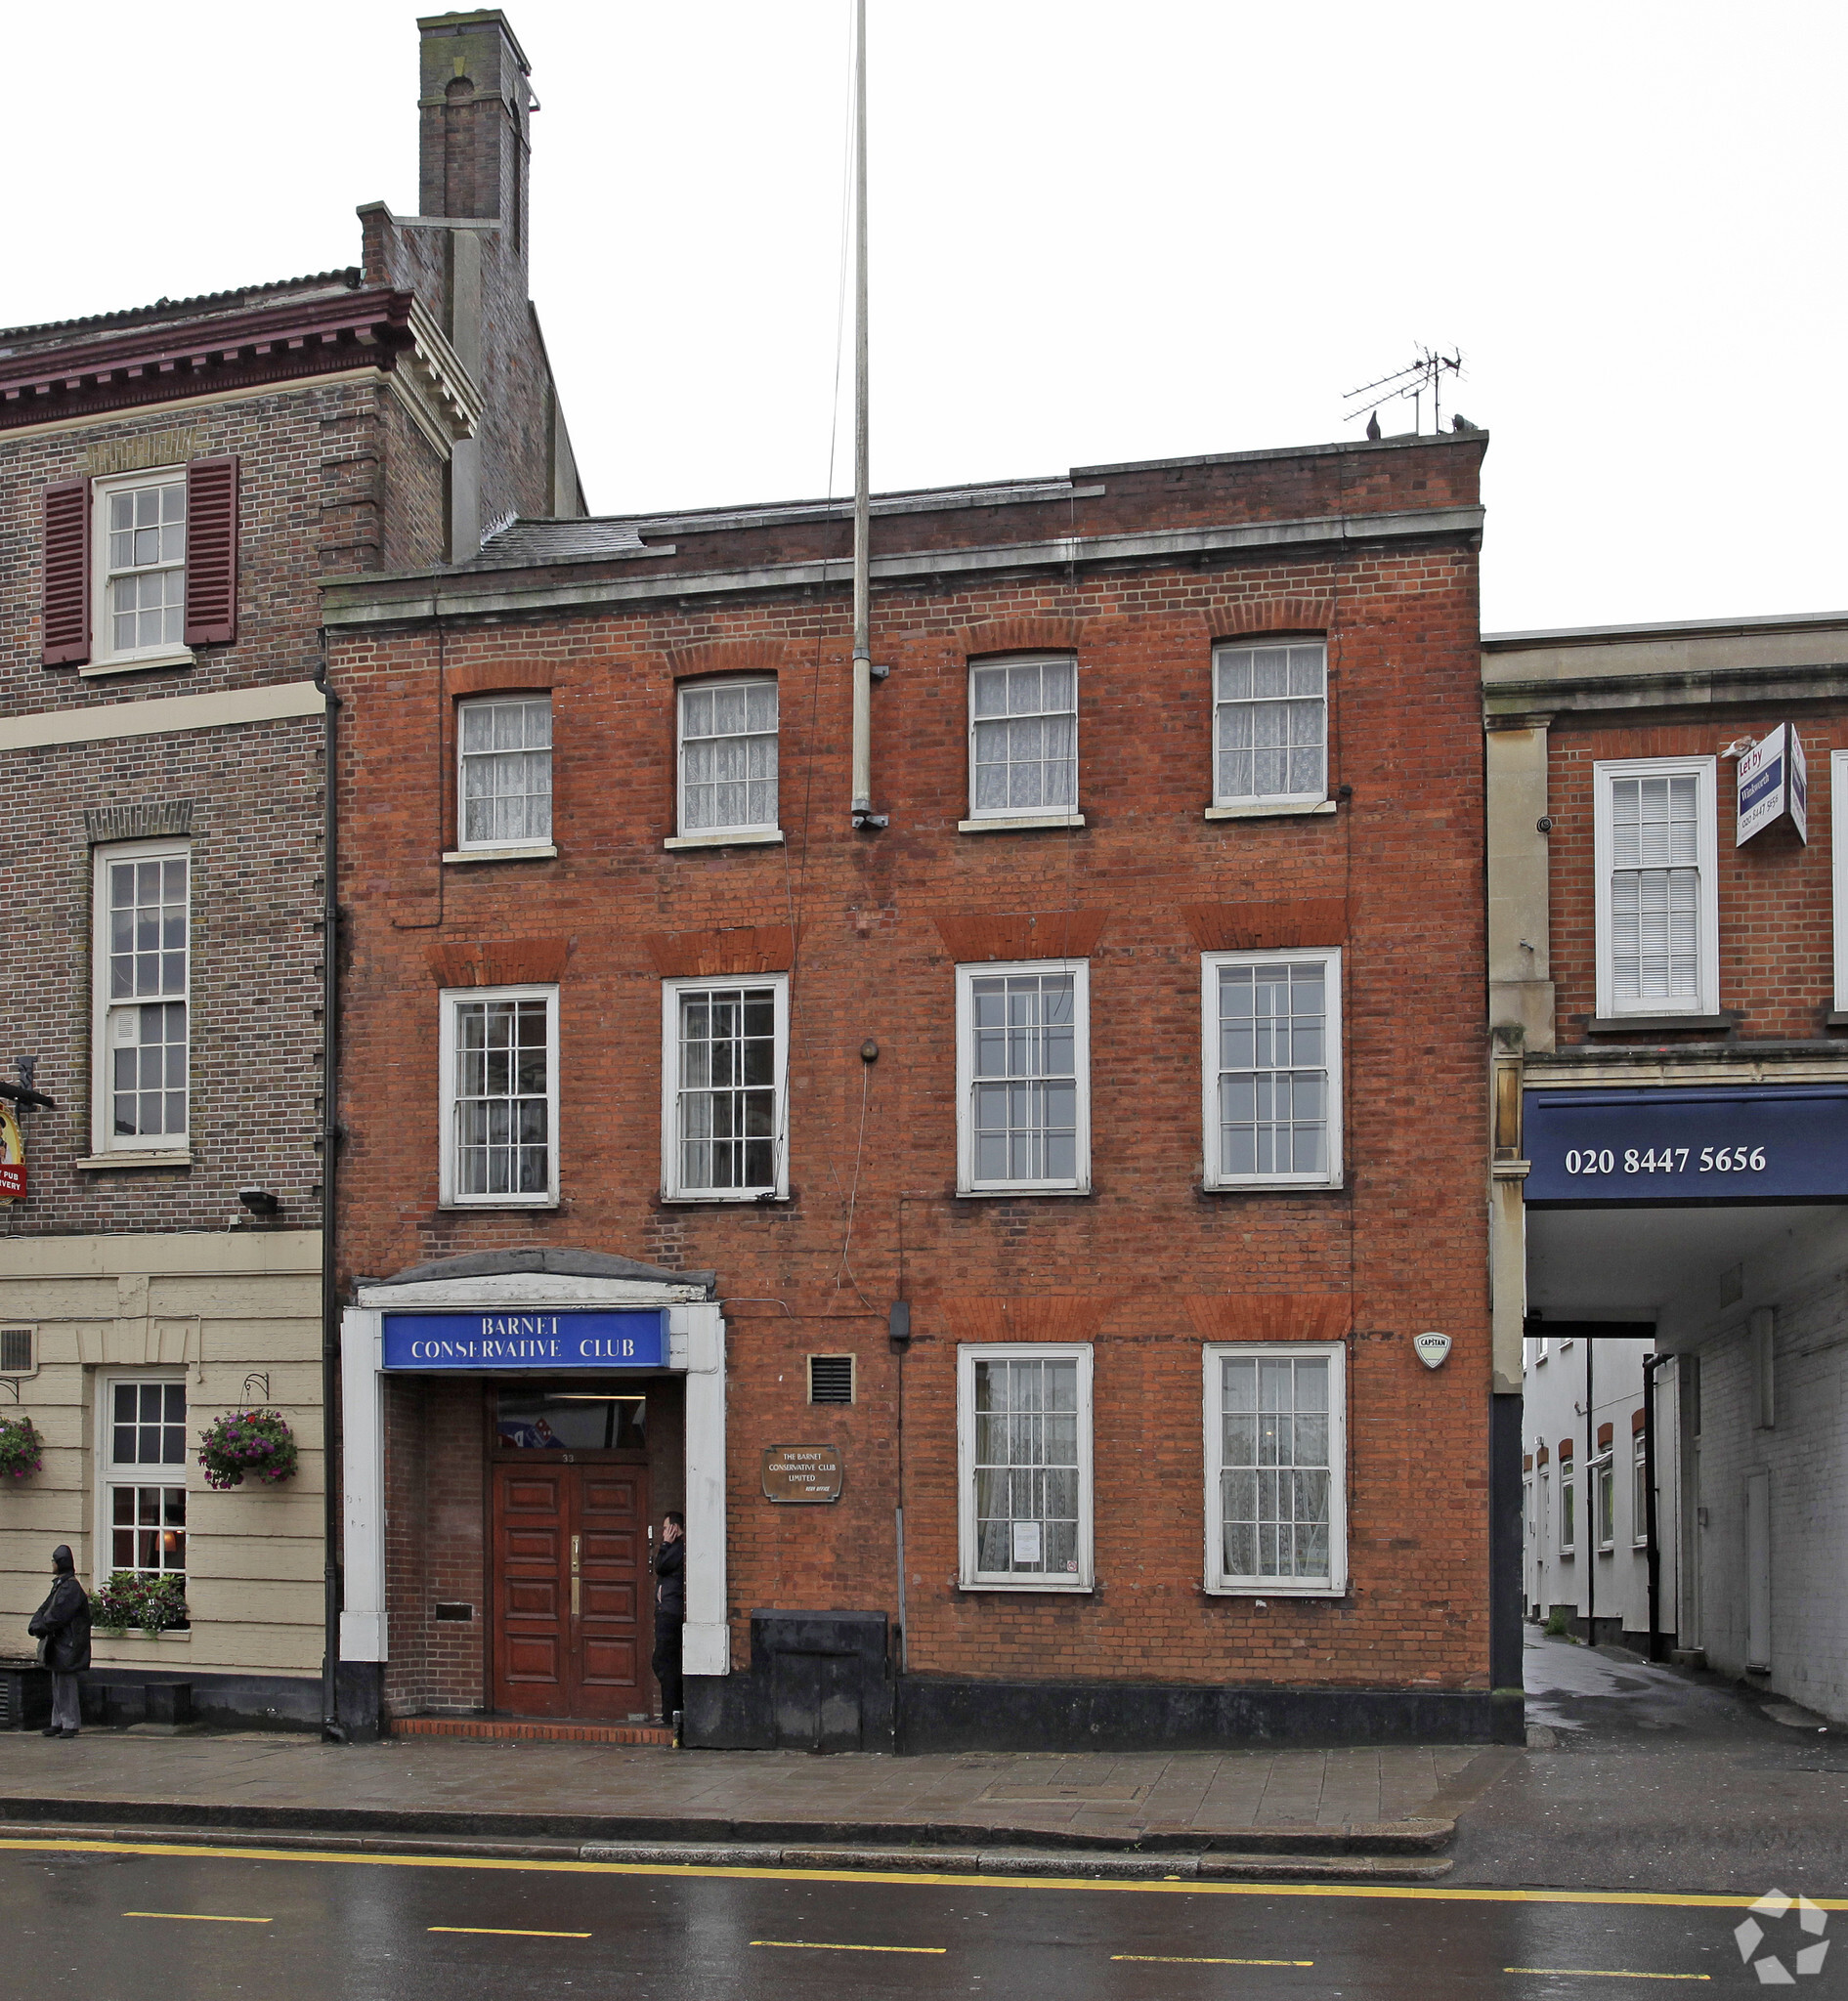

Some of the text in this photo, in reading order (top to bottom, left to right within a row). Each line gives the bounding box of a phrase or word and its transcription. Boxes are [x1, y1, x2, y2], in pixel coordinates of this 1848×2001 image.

[1740, 748, 1763, 777] Let by
[1741, 772, 1770, 801] Winkworth
[1565, 1146, 1766, 1174] 020 8447 5656
[3, 1171, 19, 1181] PUB
[482, 1317, 561, 1335] BARNET
[411, 1339, 635, 1359] CONSERVATIVE CLUB
[562, 1454, 575, 1463] 33
